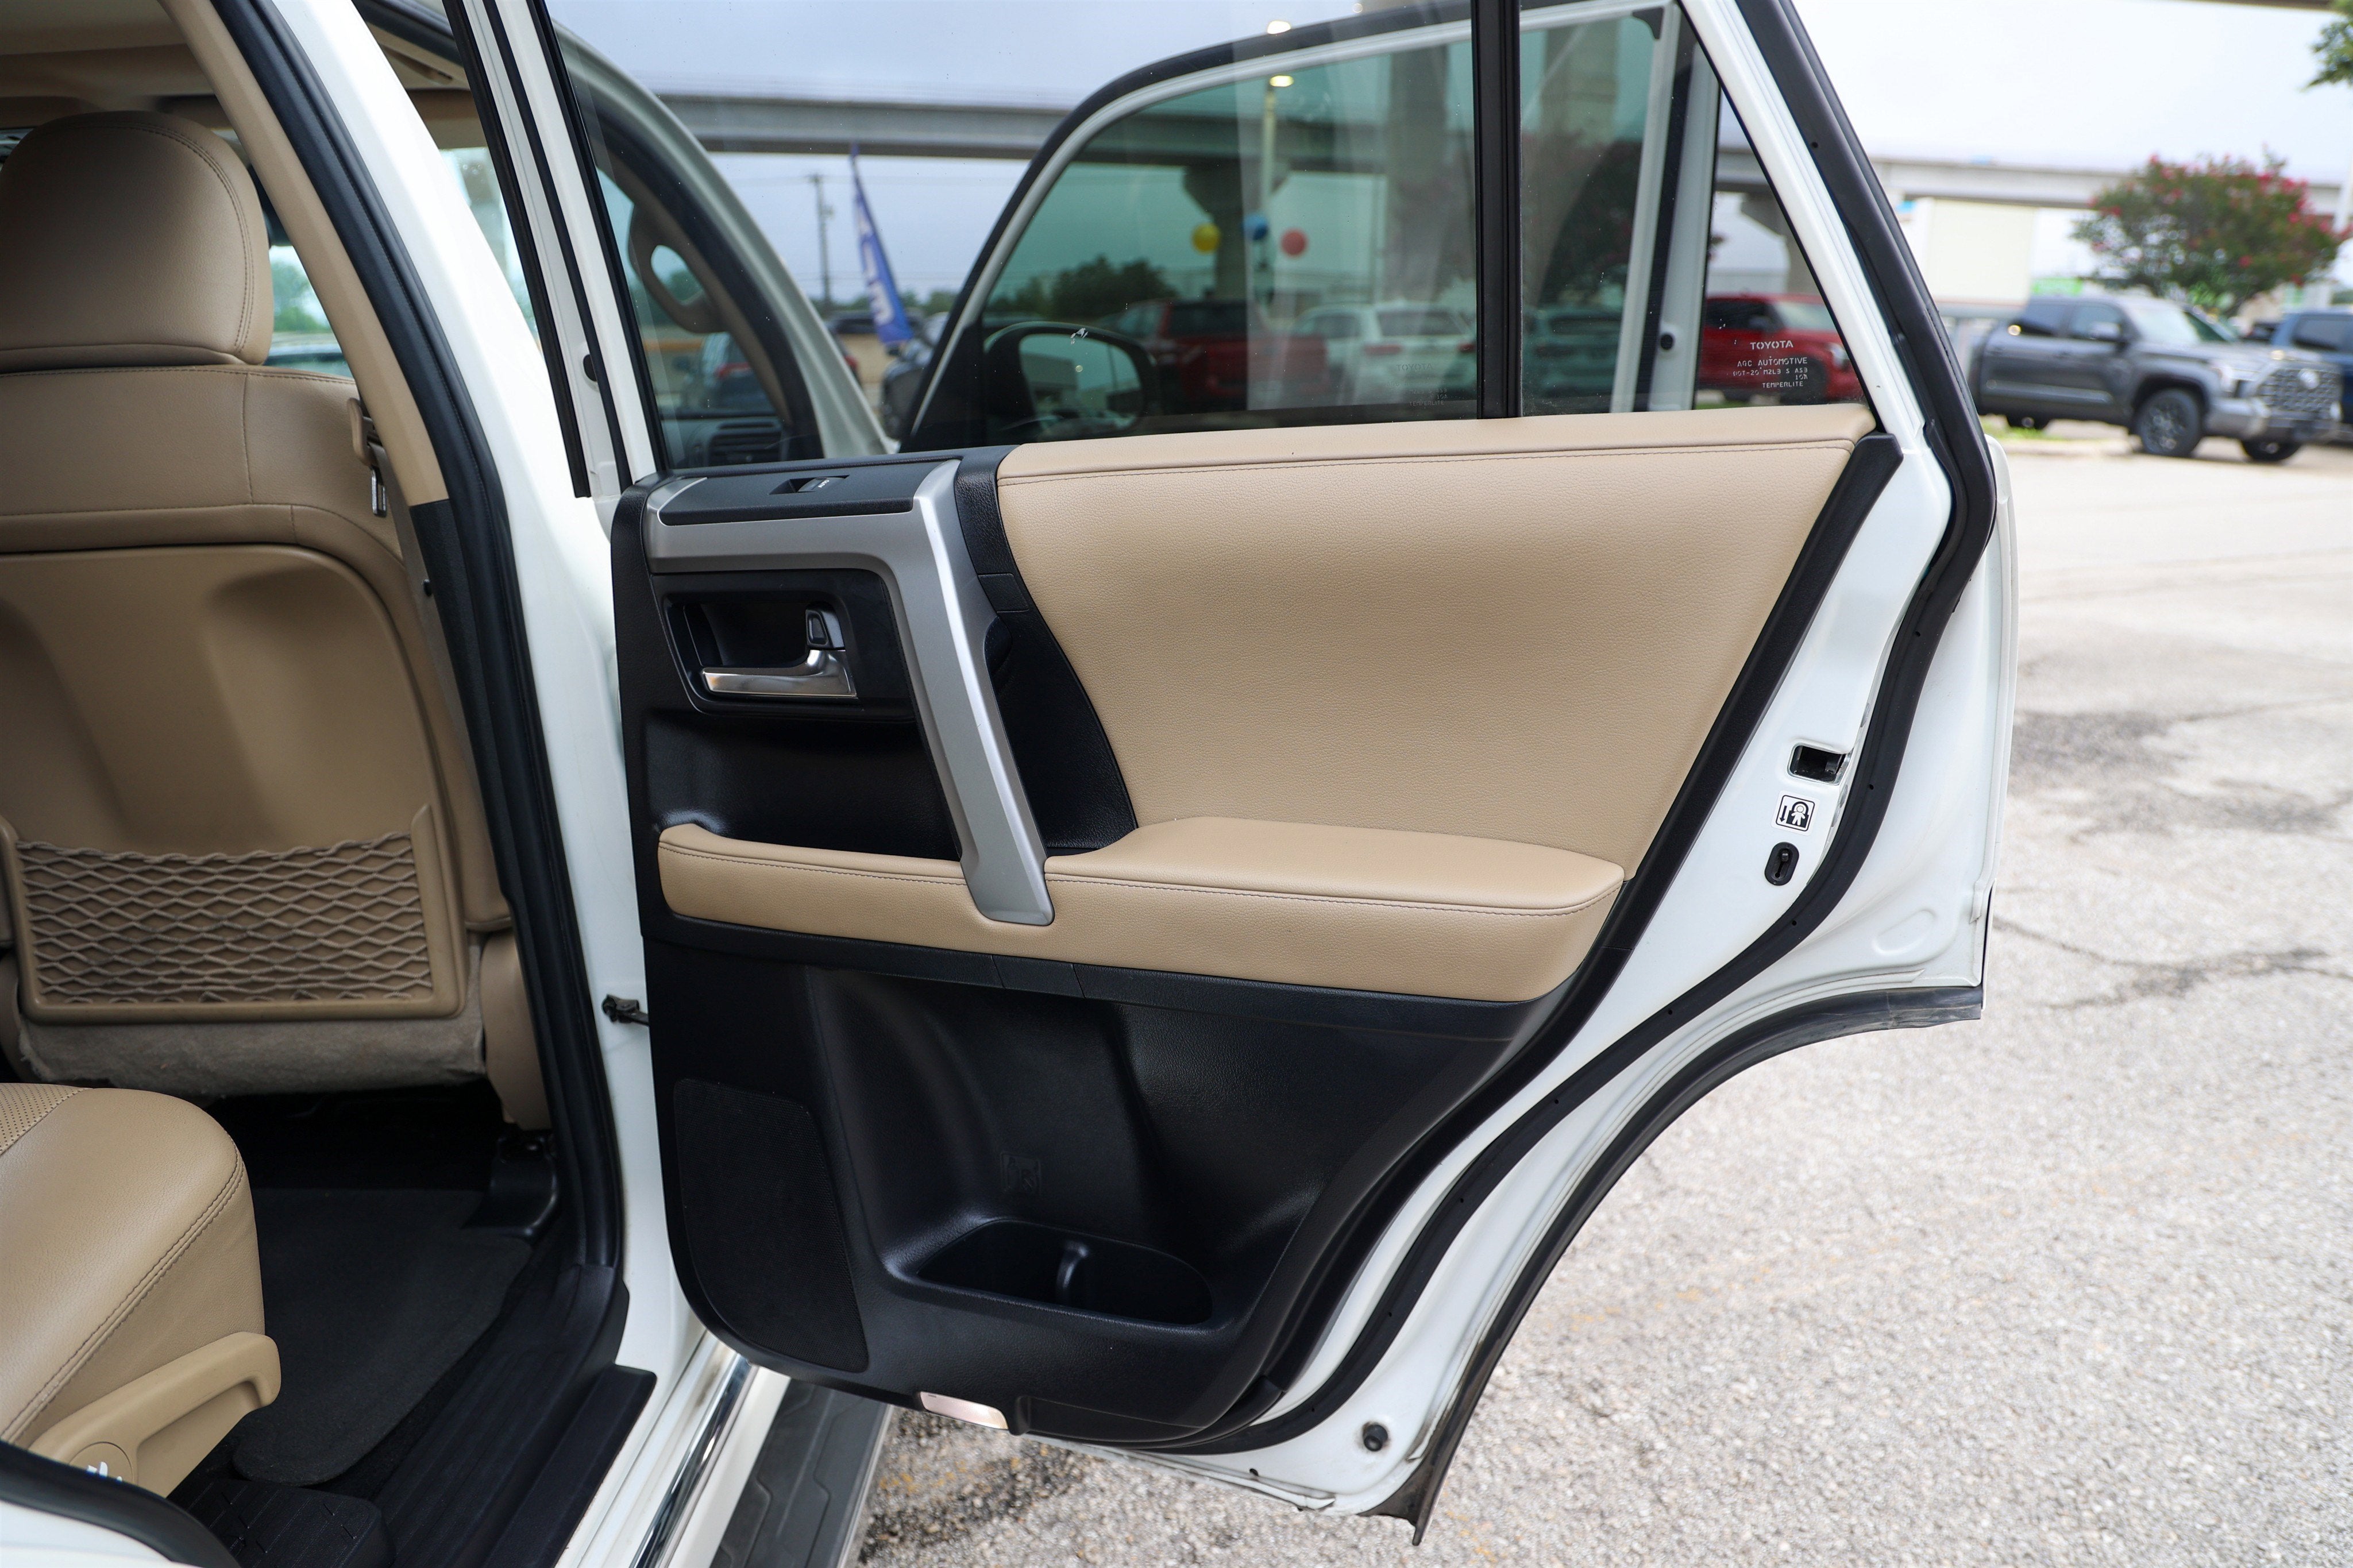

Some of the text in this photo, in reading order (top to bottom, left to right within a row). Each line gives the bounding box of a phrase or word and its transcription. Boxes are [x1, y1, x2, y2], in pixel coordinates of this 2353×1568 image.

[1750, 340, 1793, 350] TOYOTA
[1758, 357, 1808, 366] AUTOMOTIVE
[1396, 363, 1433, 371] TOYOTA
